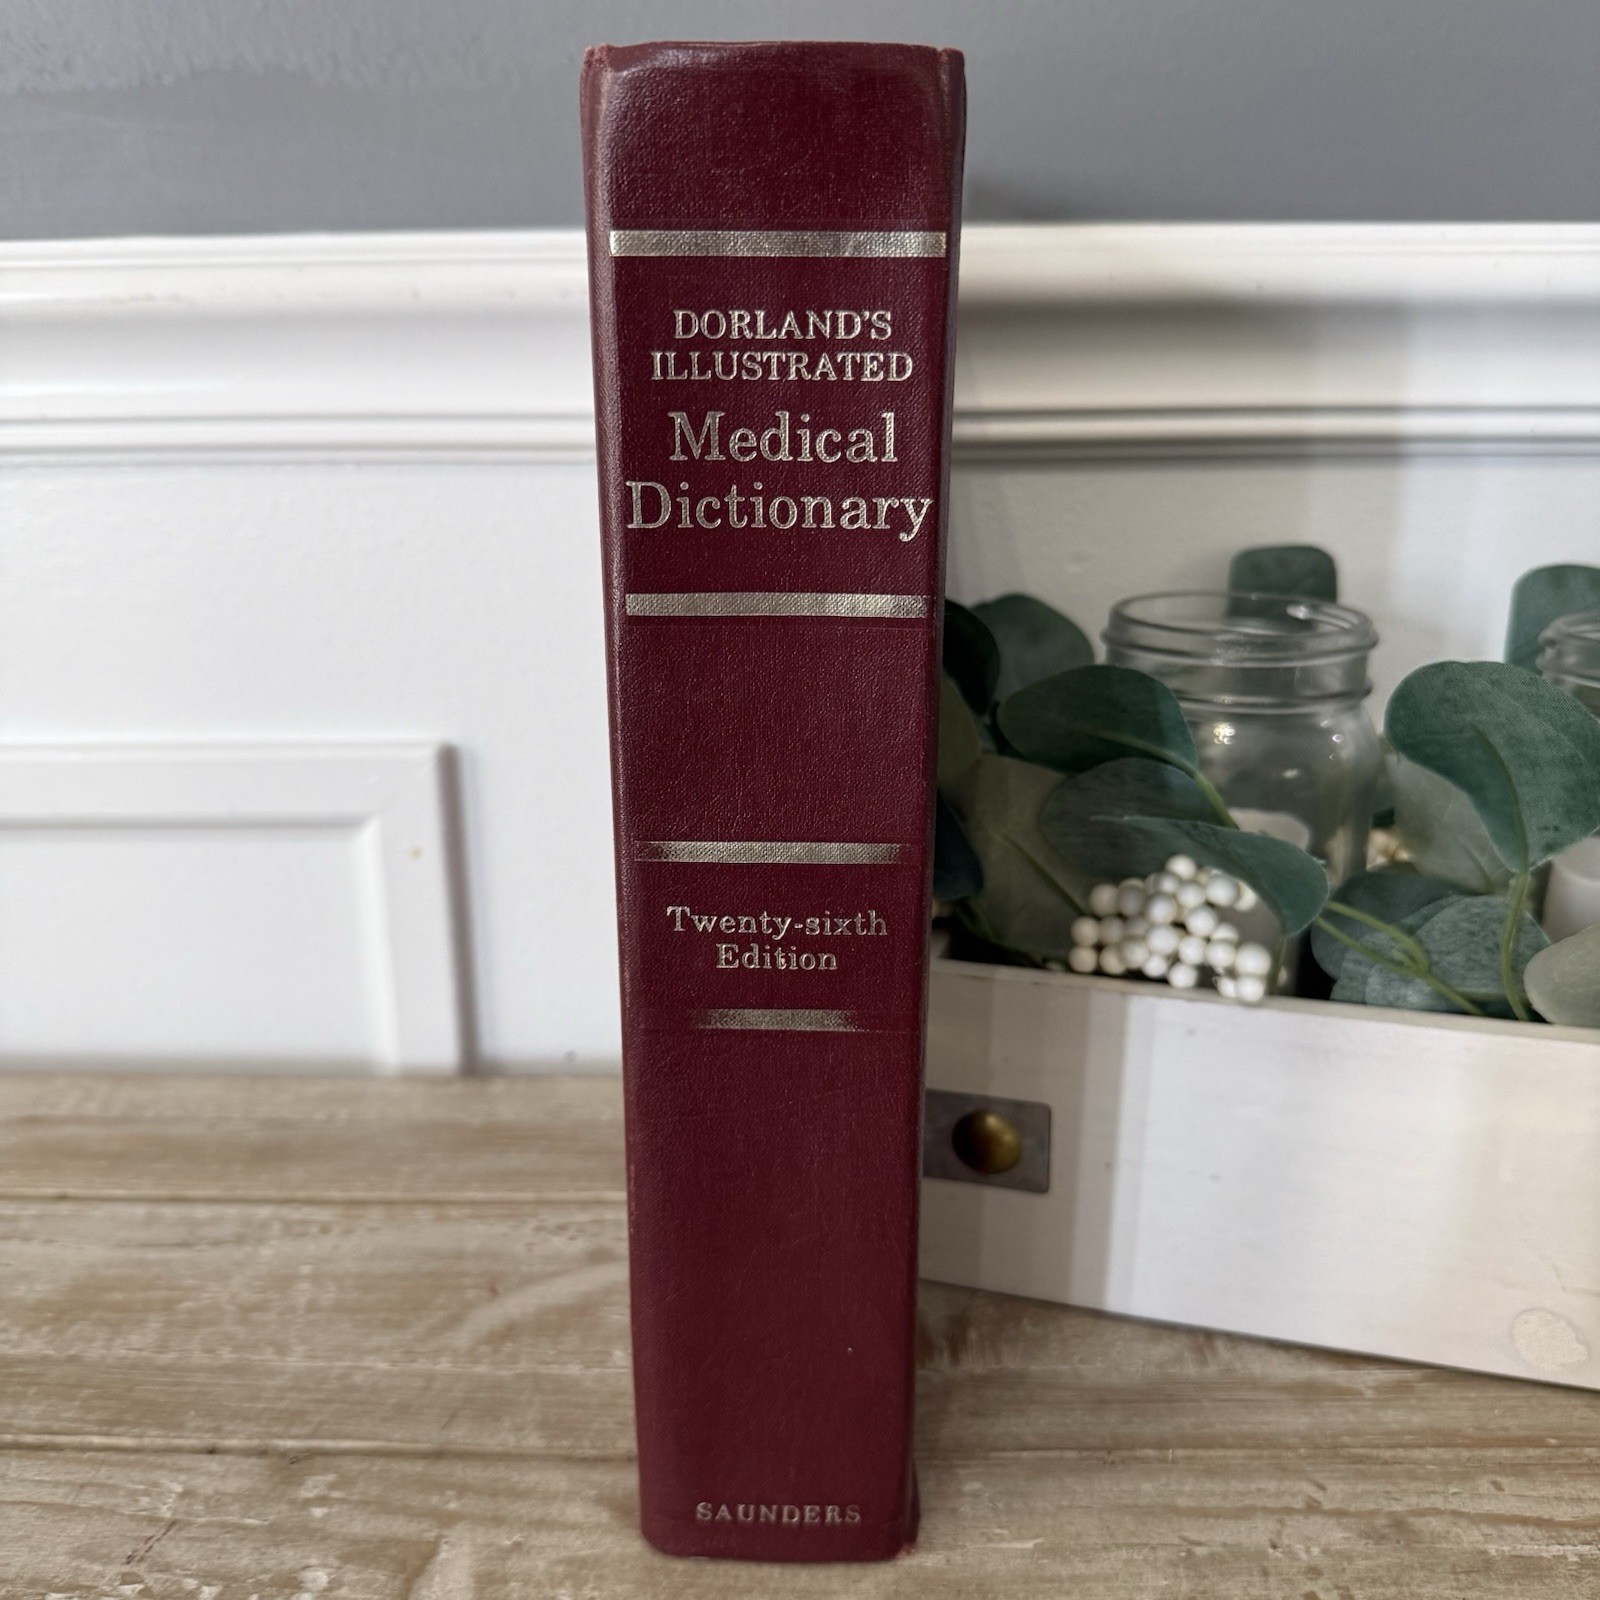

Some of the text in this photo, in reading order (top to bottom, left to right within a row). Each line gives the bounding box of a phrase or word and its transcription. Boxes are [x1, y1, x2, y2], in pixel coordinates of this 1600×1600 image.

[674, 310, 892, 340] DORLAND'S
[652, 352, 913, 381] ILLUSTRATED
[669, 411, 898, 463] Medical
[626, 481, 934, 542] Dictionary
[667, 906, 888, 940] Twenty-sixth
[716, 943, 838, 970] Edition
[696, 1502, 861, 1524] SAUNDERS
